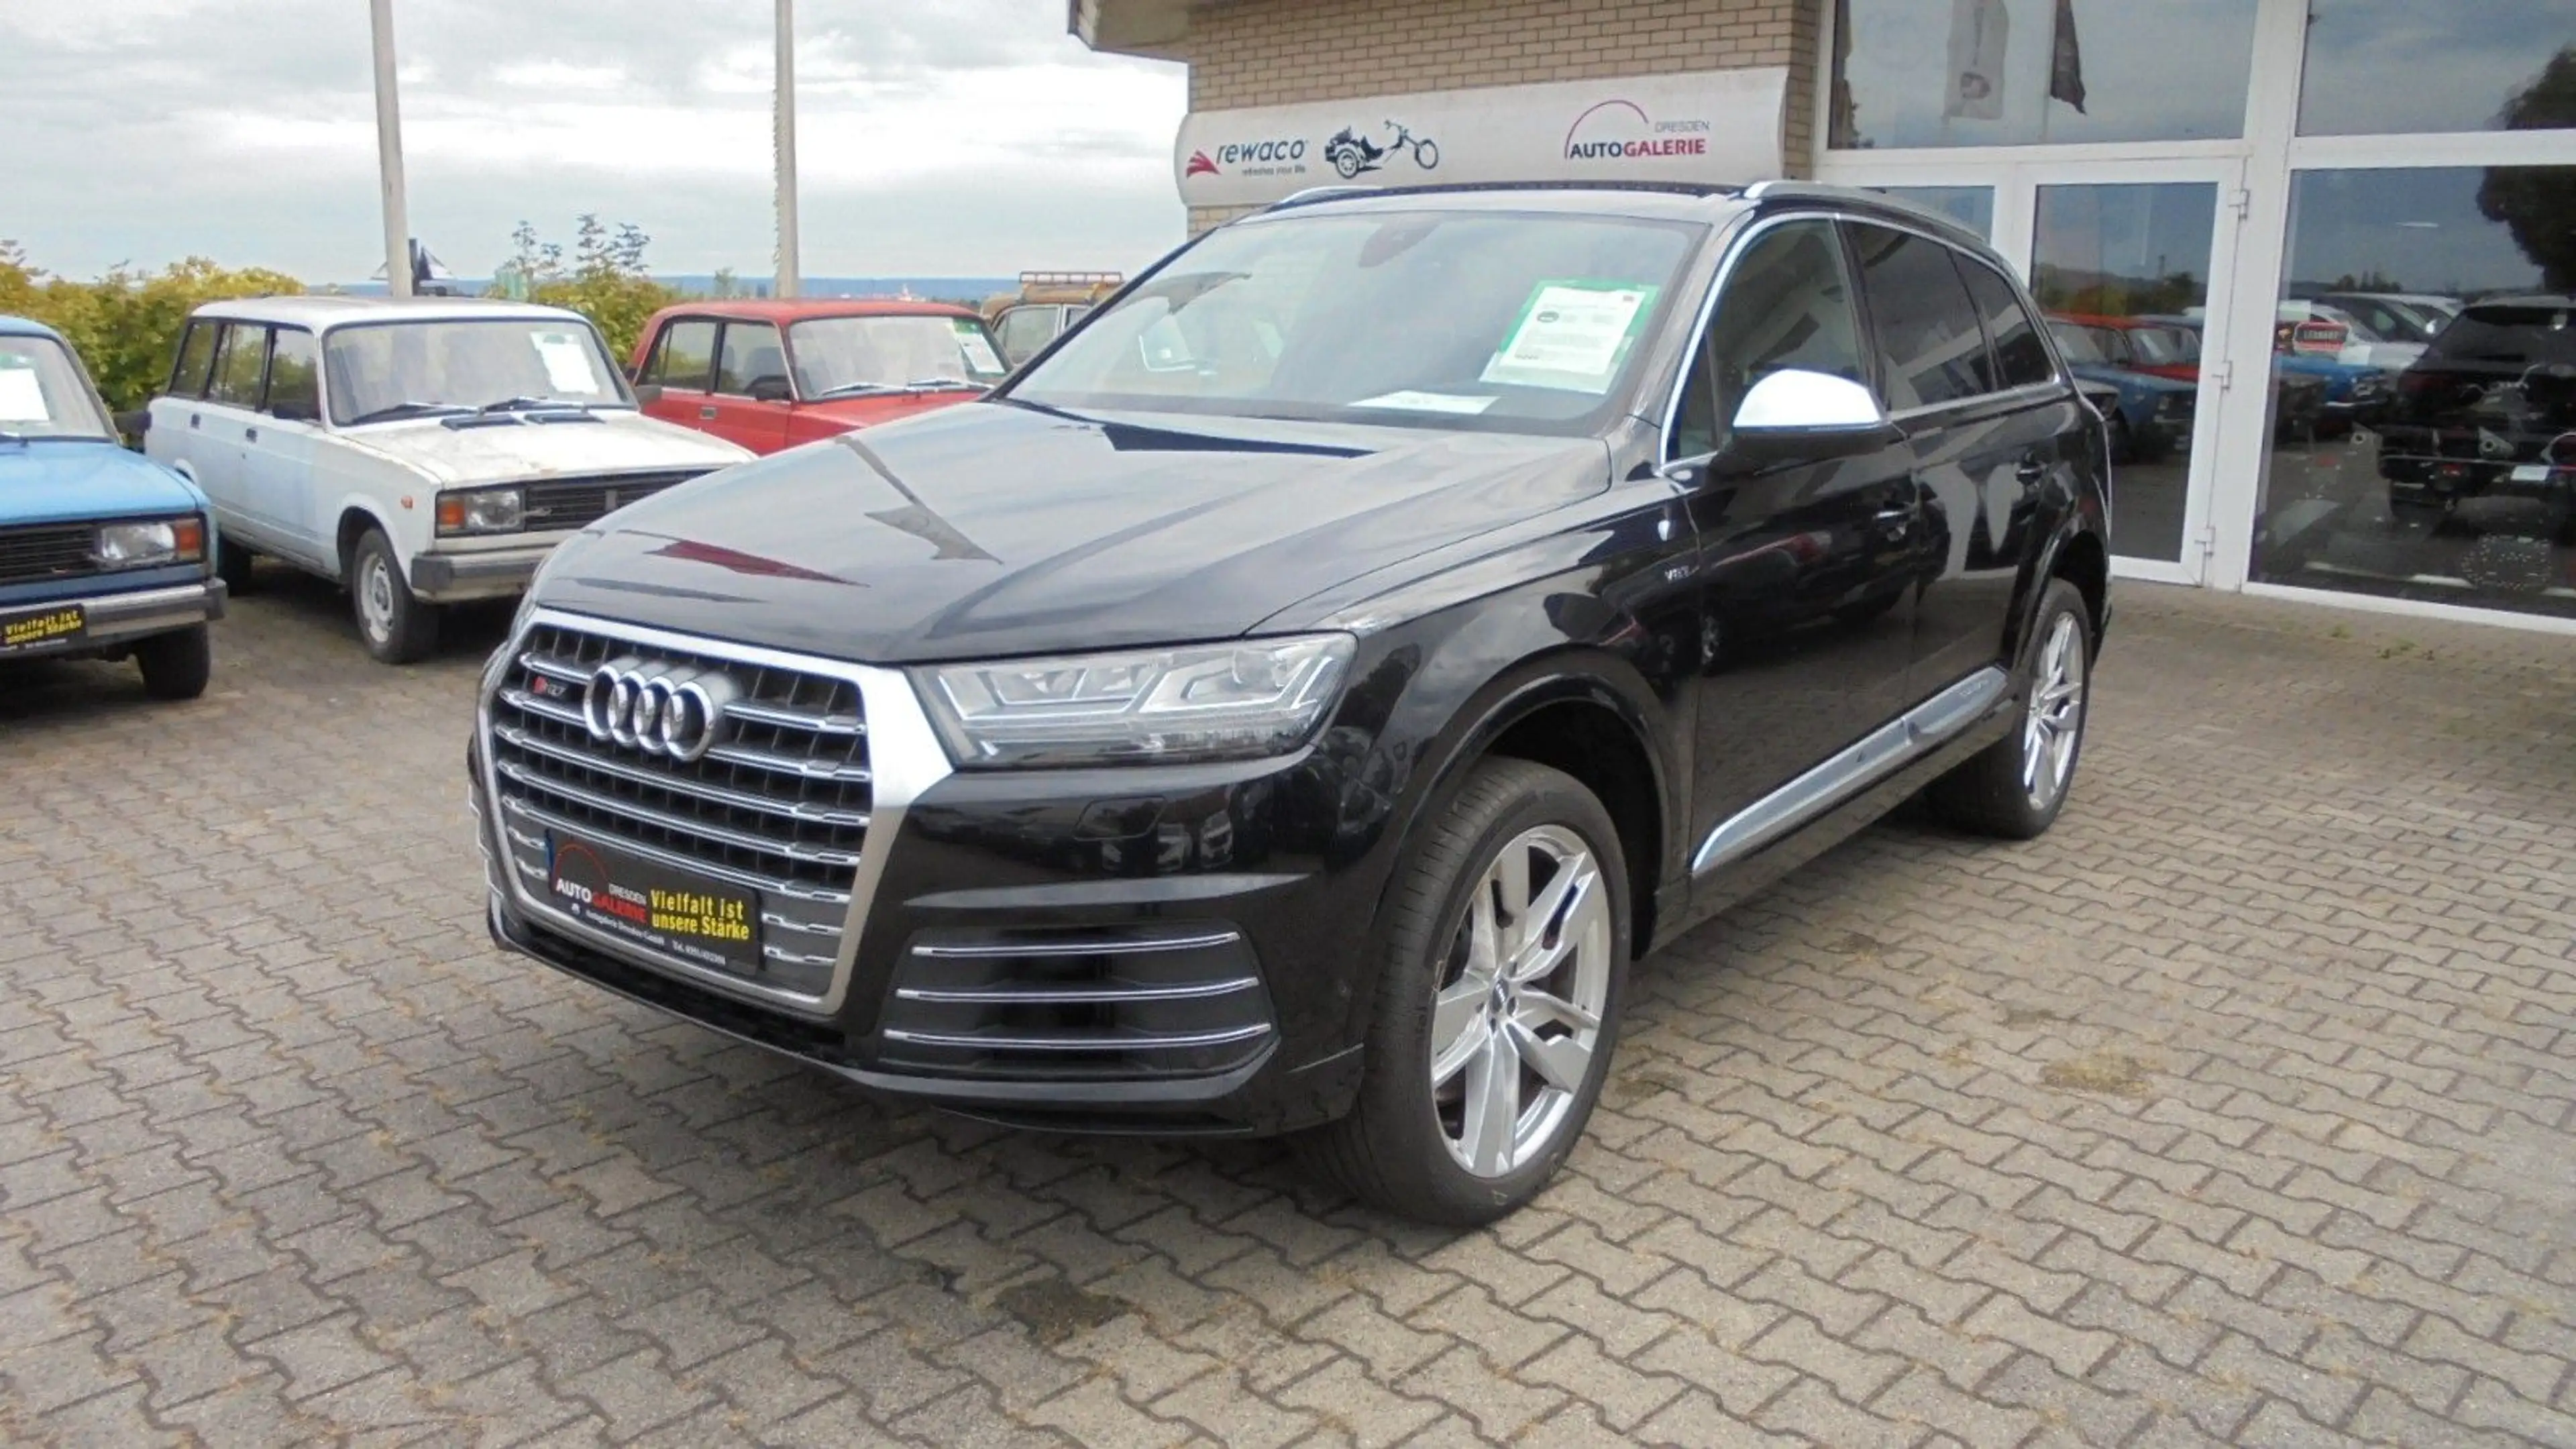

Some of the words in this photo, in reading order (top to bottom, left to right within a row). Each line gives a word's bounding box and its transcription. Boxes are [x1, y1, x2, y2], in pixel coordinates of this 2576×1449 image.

[1654, 119, 1710, 133] DRESDEN
[1216, 140, 1305, 165] rewaco
[1570, 138, 1707, 160] AUTOGALERIE
[650, 888, 713, 916] Vielfalt
[719, 898, 744, 920] ist
[651, 912, 698, 934] unsere
[701, 916, 750, 940] Stärke
